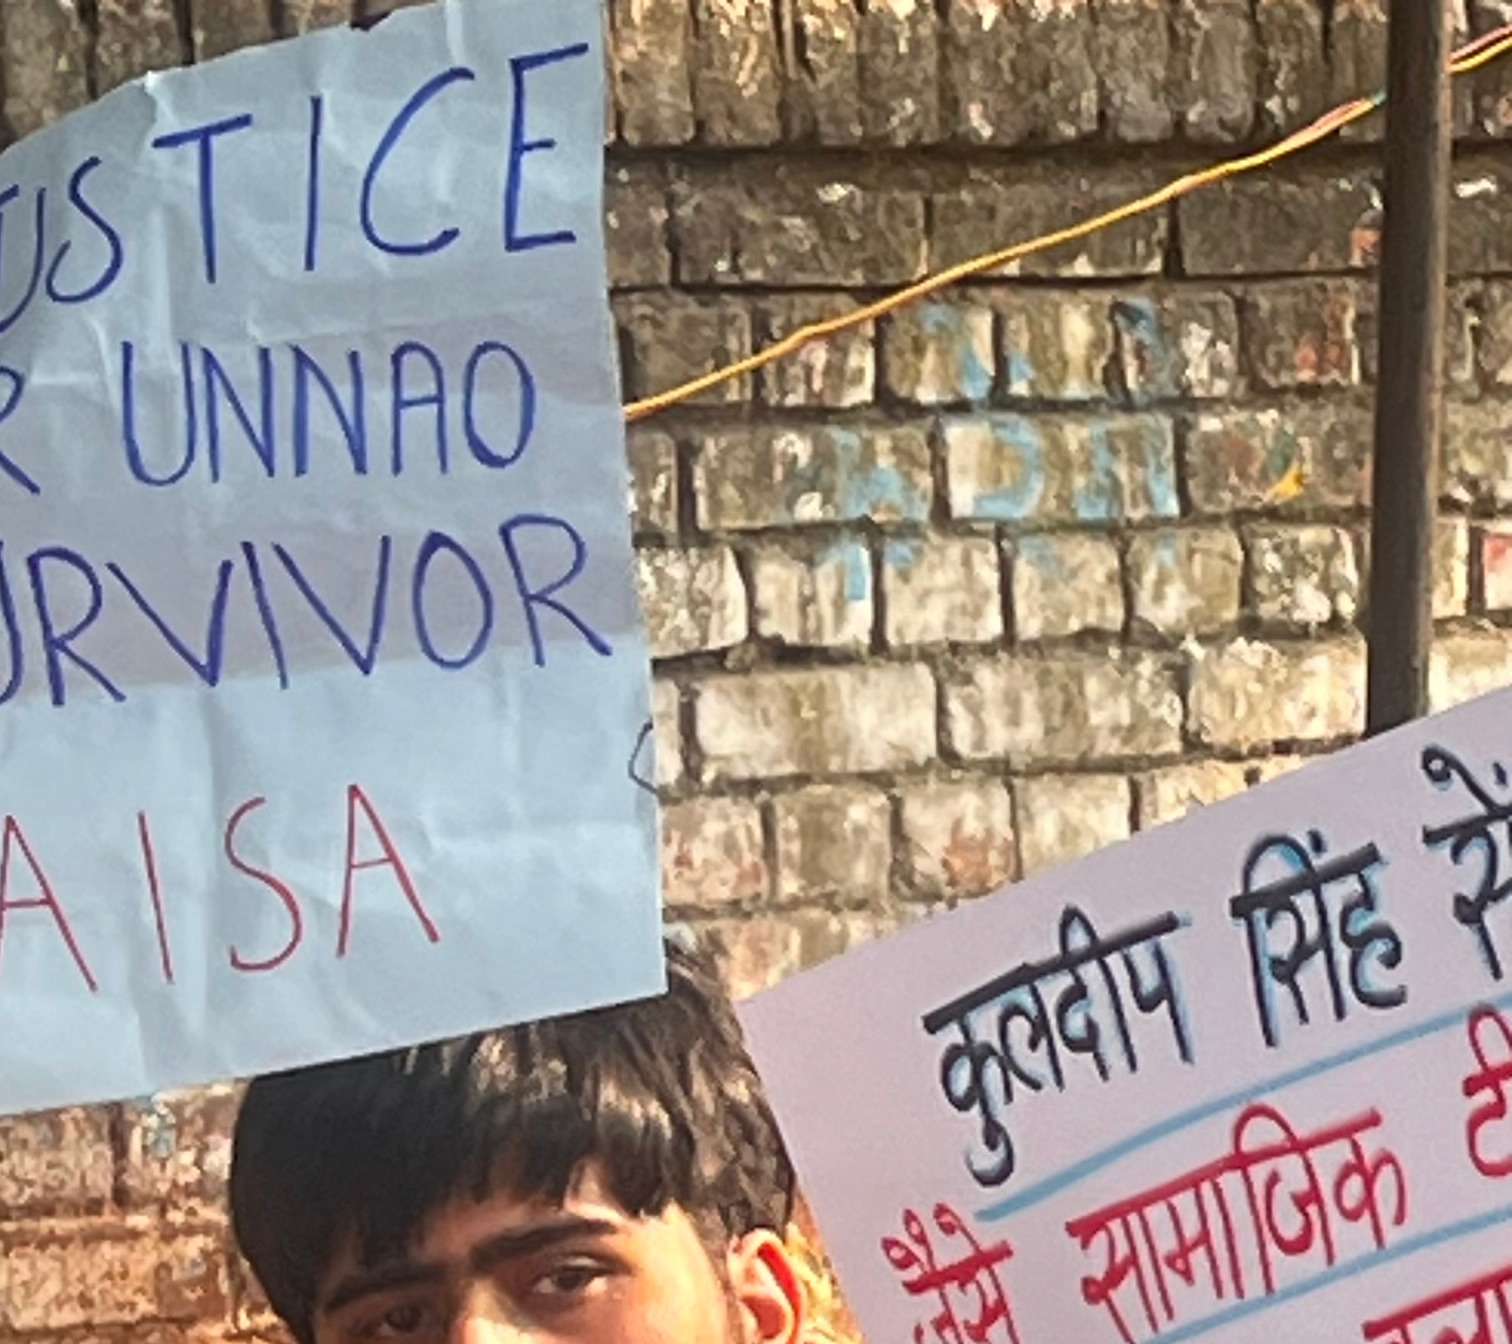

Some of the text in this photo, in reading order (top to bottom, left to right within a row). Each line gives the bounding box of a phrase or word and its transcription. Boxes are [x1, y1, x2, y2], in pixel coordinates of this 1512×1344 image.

[121, 340, 537, 487] UNNAO
[922, 906, 1188, 1186] कुलदीप
[1229, 828, 1407, 1048] सिंह
